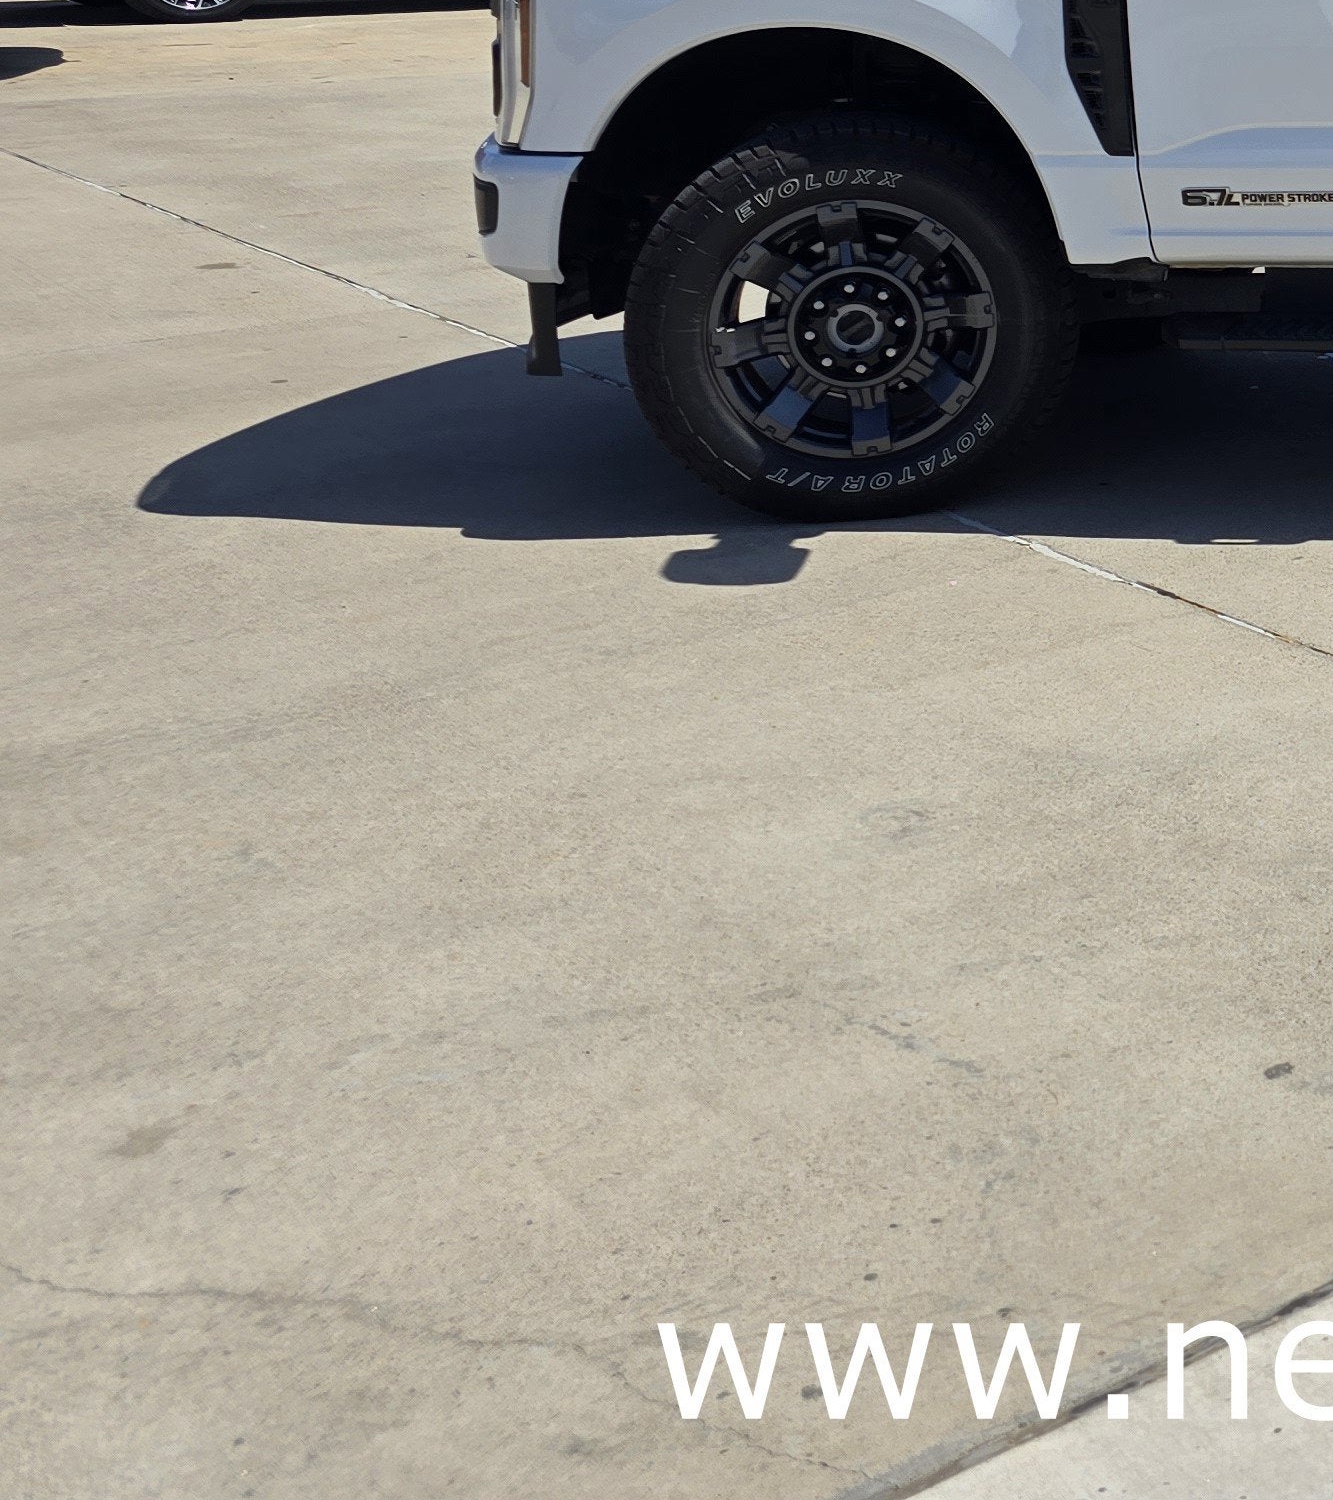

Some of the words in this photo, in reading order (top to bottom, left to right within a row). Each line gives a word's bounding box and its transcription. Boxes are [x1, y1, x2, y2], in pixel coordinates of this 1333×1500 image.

[734, 168, 903, 225] EVOLUXX
[1241, 193, 1285, 203] POWER
[841, 412, 996, 493] ROTATOR
[766, 466, 835, 492] A/T
